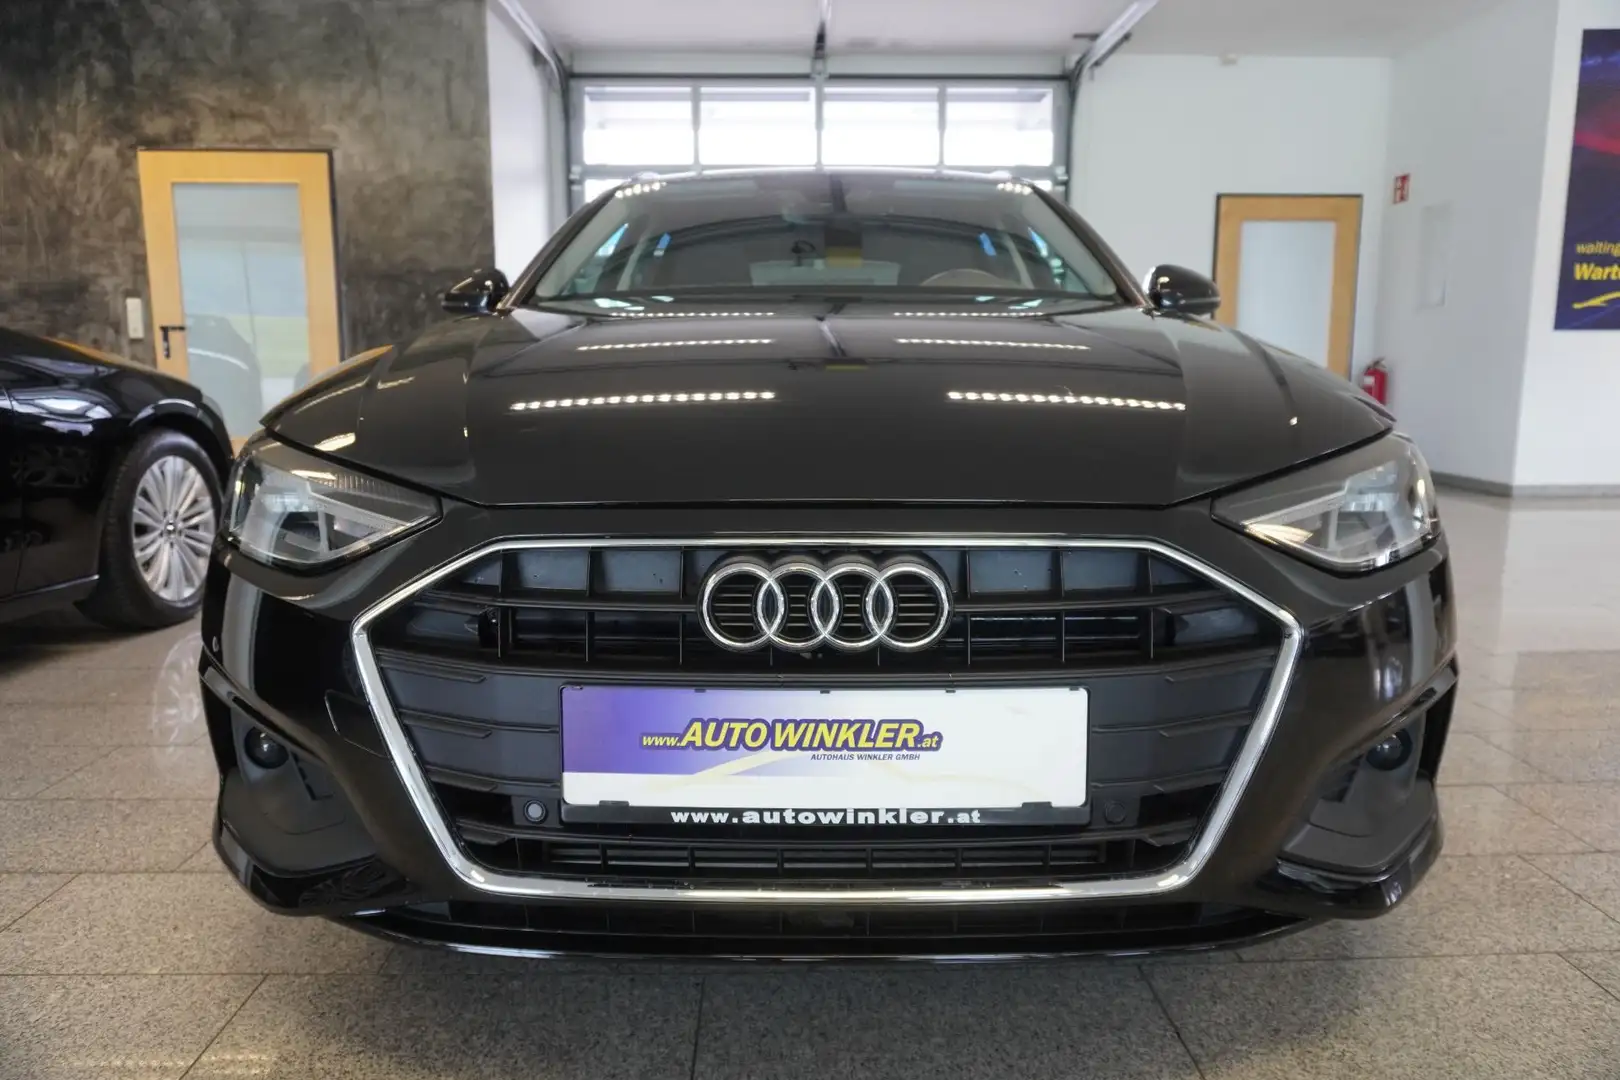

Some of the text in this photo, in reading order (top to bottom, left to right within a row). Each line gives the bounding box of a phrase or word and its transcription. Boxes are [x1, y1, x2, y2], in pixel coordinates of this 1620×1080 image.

[810, 753, 855, 761] AUTOHAUS
[857, 753, 893, 761] WINKLER
[670, 807, 981, 824] www.autowinkler.at
